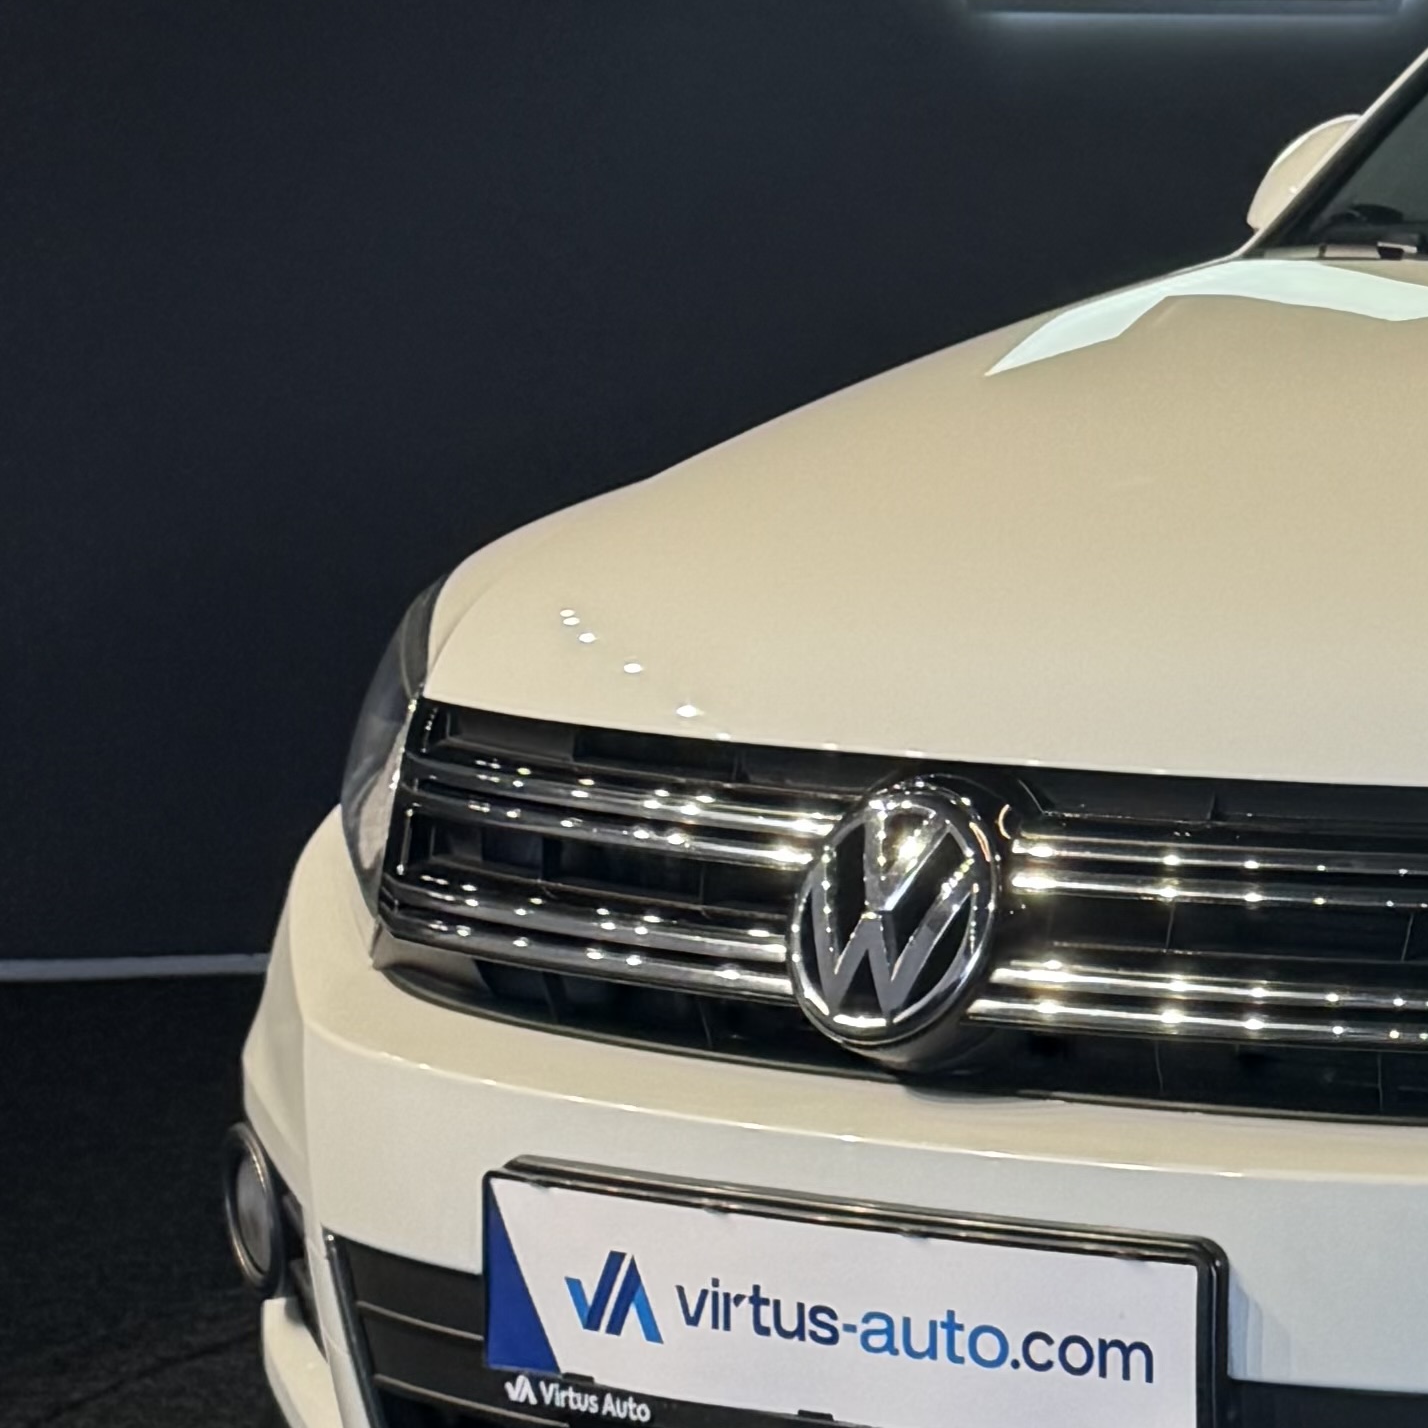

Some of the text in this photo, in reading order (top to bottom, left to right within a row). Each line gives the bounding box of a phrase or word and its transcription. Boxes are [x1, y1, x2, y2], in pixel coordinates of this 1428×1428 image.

[675, 1276, 1155, 1384] virtus-auto.com
[539, 1380, 599, 1414] Virtus
[601, 1392, 652, 1423] Auto
